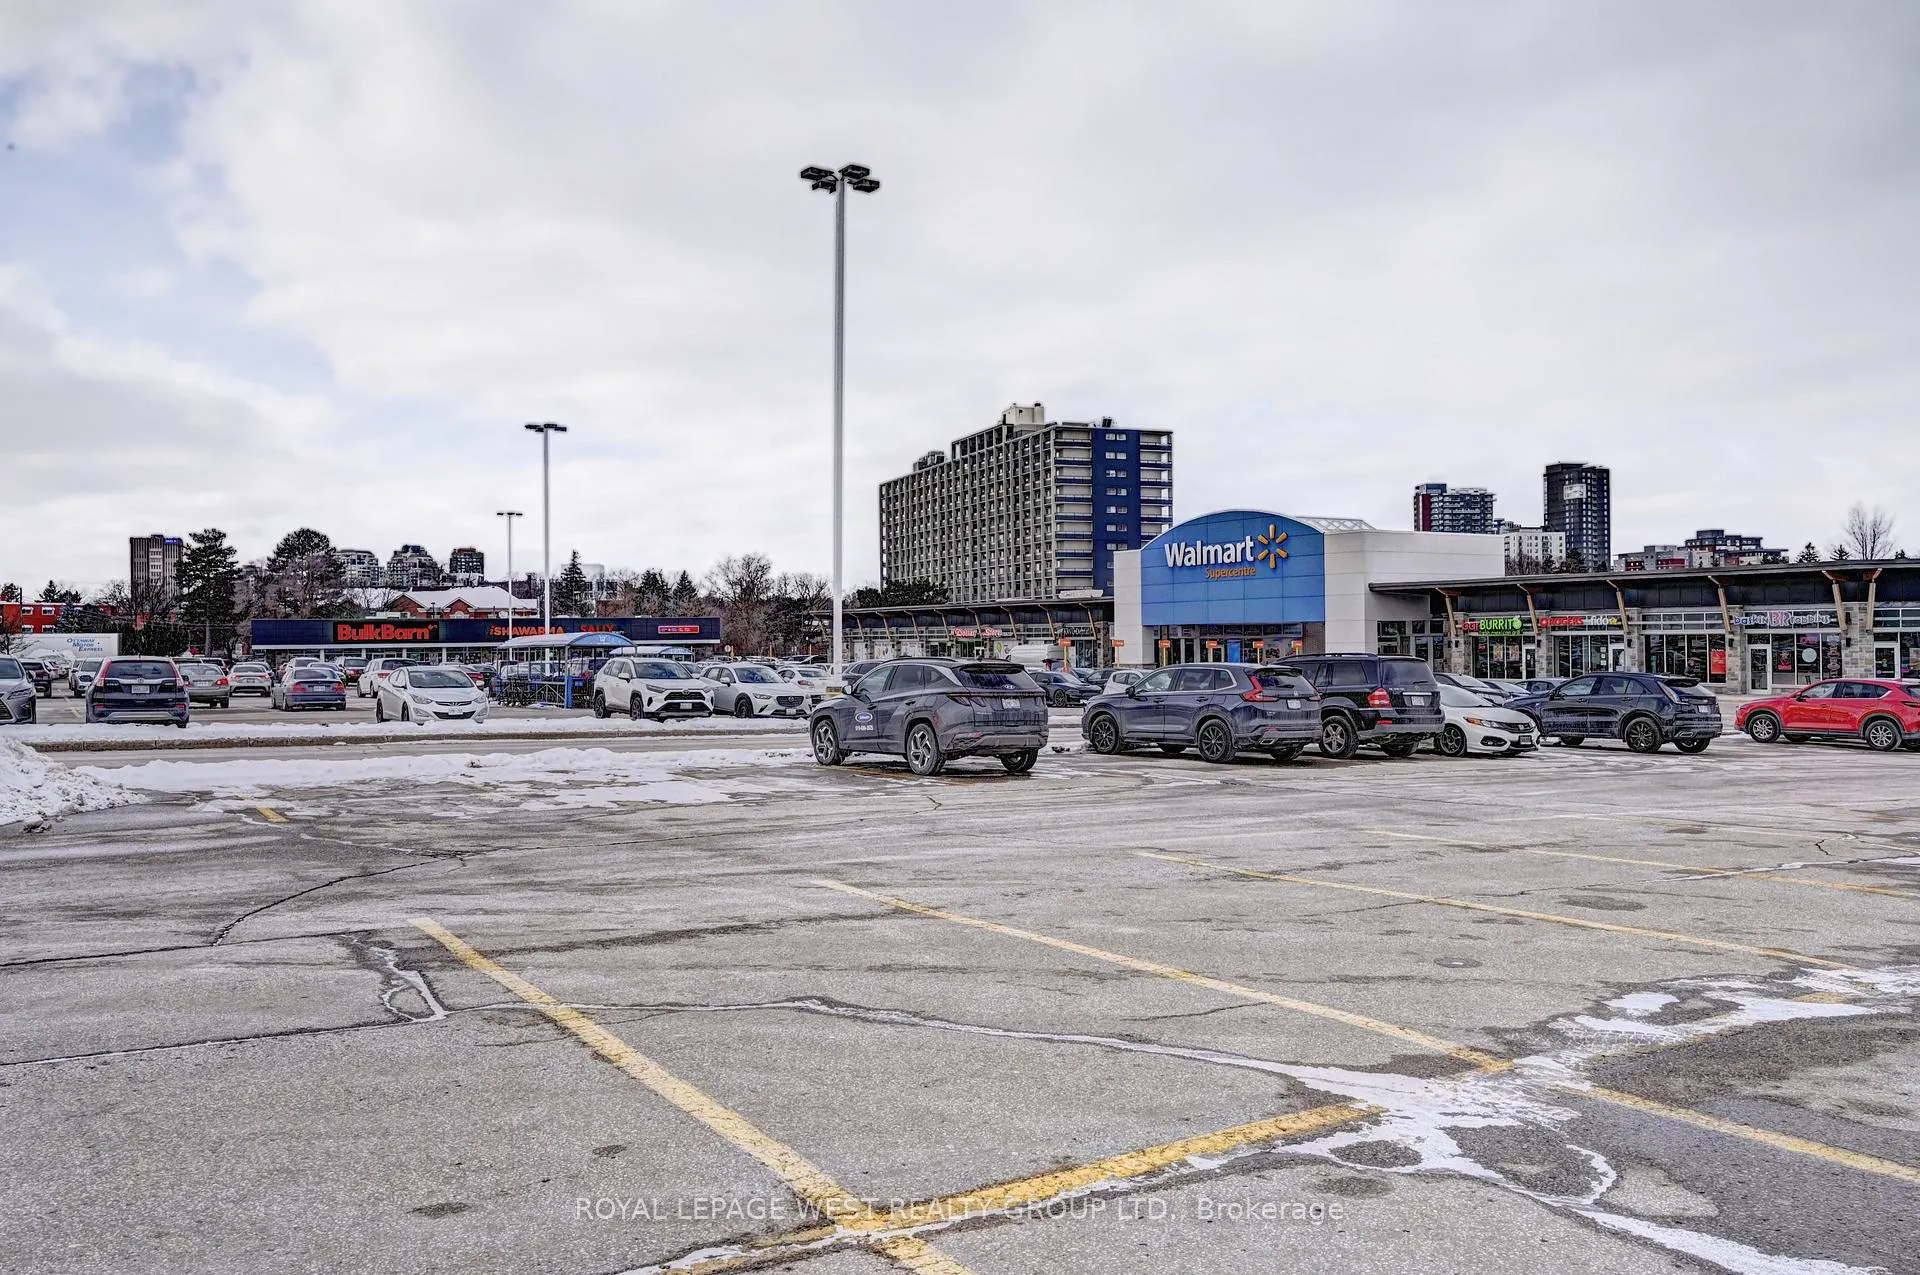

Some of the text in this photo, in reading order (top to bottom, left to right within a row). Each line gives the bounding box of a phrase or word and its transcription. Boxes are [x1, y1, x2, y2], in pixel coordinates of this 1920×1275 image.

[1164, 535, 1255, 568] Walmart
[1205, 566, 1257, 581] Supercentre
[1590, 614, 1609, 626] fido
[1771, 611, 1791, 627] BR
[337, 624, 430, 640] BulkBarn
